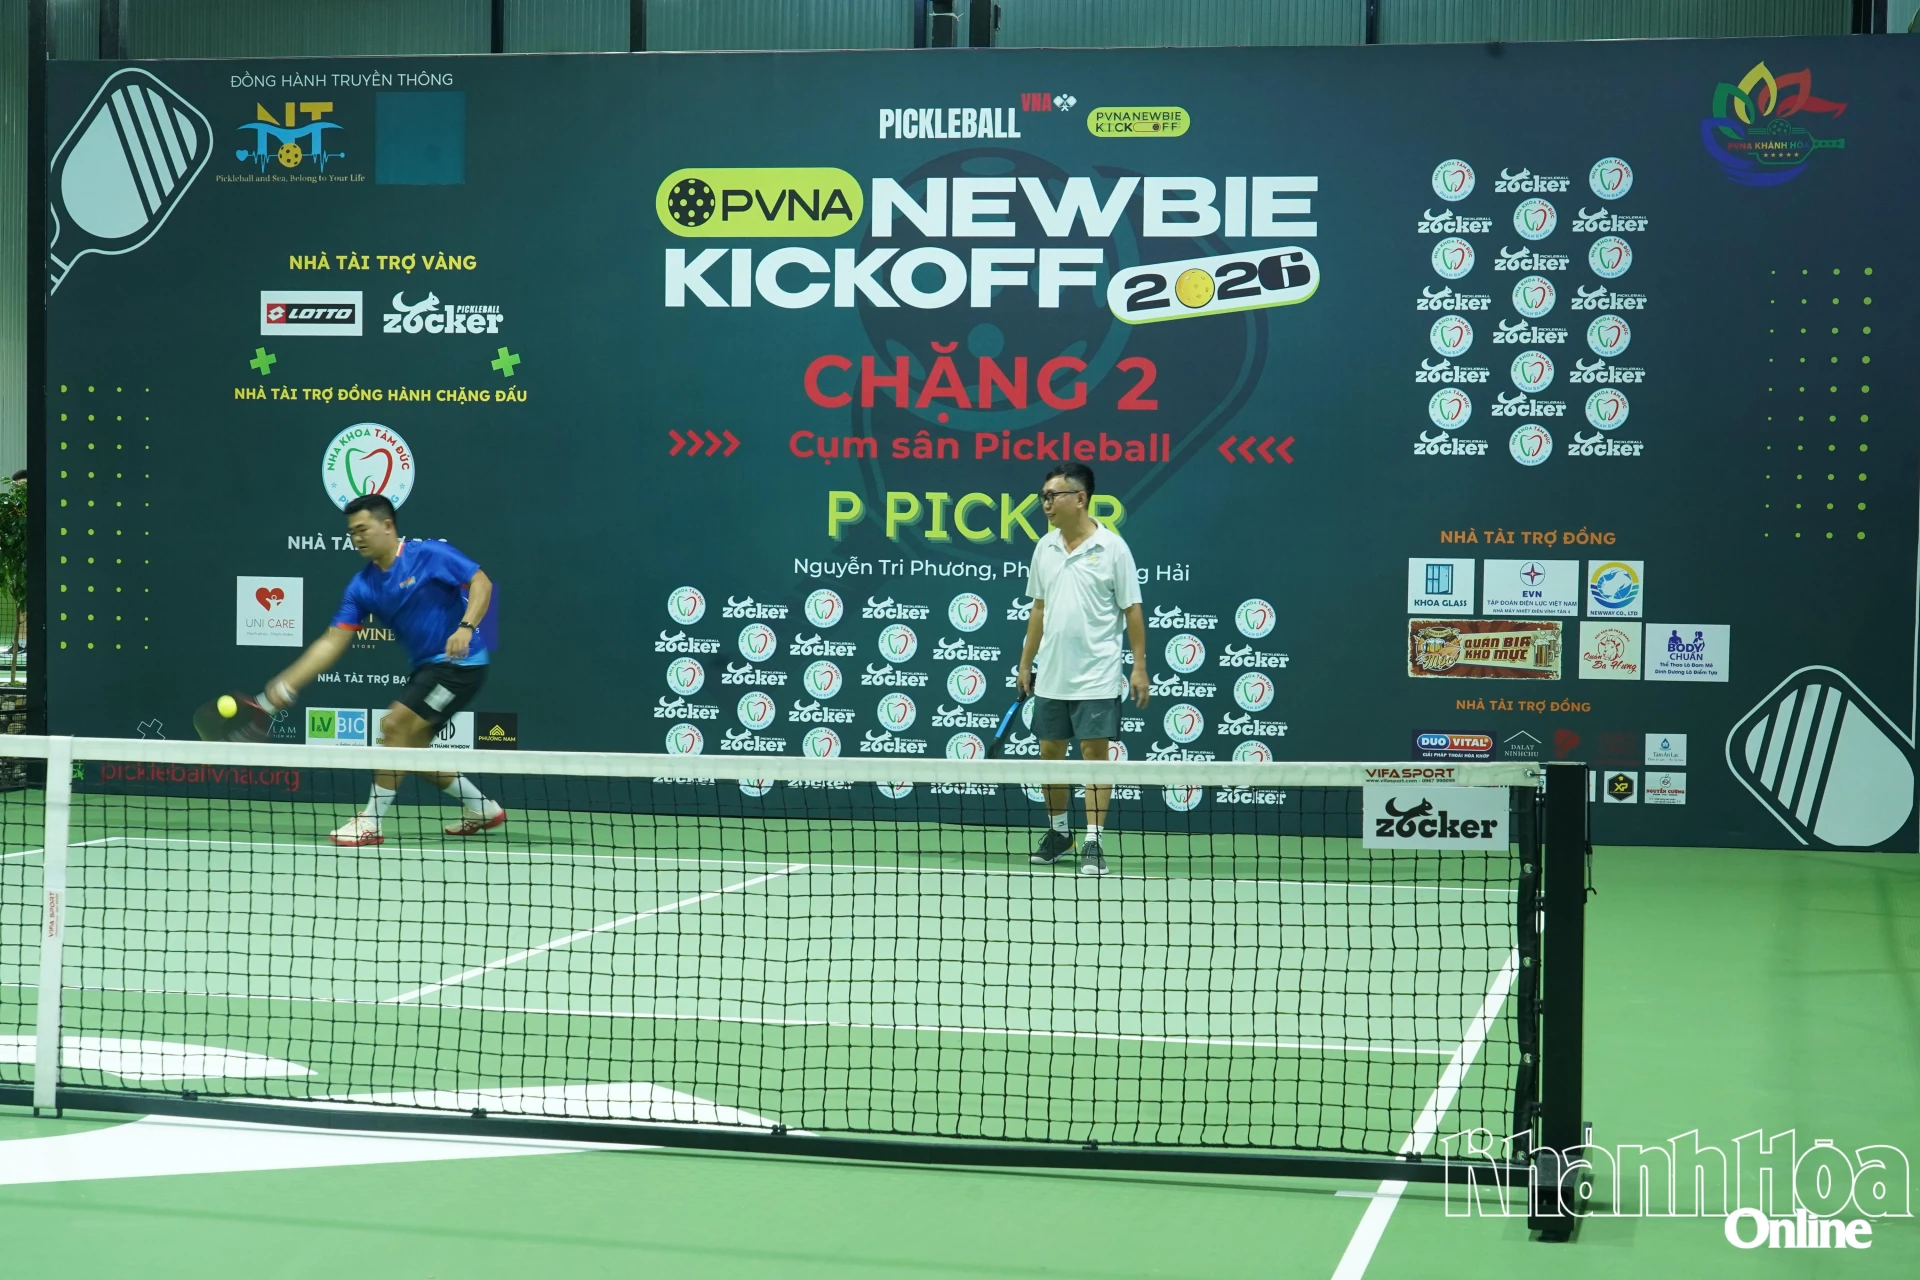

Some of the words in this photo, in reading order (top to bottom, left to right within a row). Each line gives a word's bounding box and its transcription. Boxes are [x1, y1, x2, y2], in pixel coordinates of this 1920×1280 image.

[231, 71, 276, 88] ĐỒNG
[281, 71, 327, 87] HÀNH
[331, 69, 393, 87] TRUYỀN
[397, 70, 453, 86] THÔNG
[879, 107, 1021, 139] PICKLEBALL
[1021, 92, 1052, 112] VNA
[1132, 111, 1182, 121] NEWBIE
[216, 174, 254, 183] Pickleball
[255, 174, 271, 182] and
[290, 174, 318, 184] Belong
[328, 174, 349, 182] Your
[350, 173, 366, 182] Life
[1495, 175, 1570, 193] zocker
[722, 188, 853, 222] PVNA
[871, 175, 1319, 237] NEWBIE
[1418, 215, 1492, 233] zocker
[1572, 215, 1648, 232] zocker
[289, 251, 331, 270] NHÀ
[336, 251, 370, 270] TÀI
[376, 254, 418, 275] TRỢ
[422, 251, 478, 271] VÀNG
[1495, 253, 1570, 271] zocker
[665, 246, 1103, 309] KICKOFF
[456, 305, 500, 314] PICKLEBALL
[1417, 293, 1491, 311] zocker
[1571, 292, 1647, 310] zocker
[288, 308, 353, 320] LOTTO
[383, 304, 504, 334] zocker
[1493, 327, 1568, 344] zocker
[803, 341, 1089, 424] CHẶNG
[1117, 356, 1159, 411] 2
[1415, 366, 1490, 384] zocker
[1570, 366, 1646, 384] zocker
[234, 385, 267, 400] NHÀ
[271, 385, 298, 400] TÀI
[303, 387, 334, 404] TRỢ
[337, 384, 383, 402] ĐỒNG
[388, 385, 431, 402] HÀNH
[436, 386, 491, 405] CHẶNG
[495, 384, 528, 403] ĐẤU
[1491, 399, 1566, 417] zocker
[326, 446, 342, 472] NHA
[338, 427, 371, 447] KHOA
[374, 428, 398, 447] TÂM
[394, 445, 411, 471] ĐỨC
[789, 430, 878, 466] Cụm
[891, 430, 960, 460] sân
[974, 432, 1171, 463] Pickleball
[1413, 438, 1489, 456] zocker
[1568, 438, 1644, 457] zocker
[828, 489, 866, 543] P
[885, 490, 1129, 545] PICKR
[287, 532, 326, 551] NHÀ
[331, 532, 359, 551] TÀ
[1440, 527, 1478, 545] NHÀ
[1484, 527, 1515, 544] TÀI
[1521, 529, 1556, 548] TRỢ
[1562, 526, 1617, 546] ĐỒNG
[794, 556, 874, 580] Nguyễn
[878, 559, 904, 576] Tri
[910, 559, 997, 581] Phương,
[1155, 562, 1191, 582] Hải
[1414, 599, 1440, 607] KHOA
[1441, 599, 1468, 607] GLASS
[1522, 590, 1543, 598] EVN
[722, 603, 789, 620] zocker
[862, 603, 930, 620] zocker
[246, 618, 265, 628] UNI
[267, 618, 296, 629] CARE
[356, 628, 396, 641] WINE
[1464, 636, 1501, 649] QUÁN
[1503, 635, 1532, 649] BIA
[654, 637, 721, 654] zocker
[933, 645, 1001, 663] zocker
[1668, 643, 1703, 653] BODY
[1219, 652, 1290, 669] zocker
[317, 672, 341, 684] NHÀ
[344, 672, 363, 684] TÀI
[367, 674, 390, 686] TRỢ
[1456, 697, 1486, 711] NHÀ
[1489, 698, 1514, 711] TÀI
[1518, 700, 1546, 714] TRỢ
[1550, 697, 1592, 713] ĐỒNG
[789, 706, 856, 724] zocker
[932, 712, 1000, 729] zocker
[311, 717, 332, 732] I&V
[337, 717, 365, 733] BIO
[1218, 719, 1288, 737] zocker
[860, 736, 928, 754] zocker
[1421, 737, 1447, 746] DUO
[1504, 750, 1540, 758] NINHCHU
[1376, 810, 1498, 839] zocker
